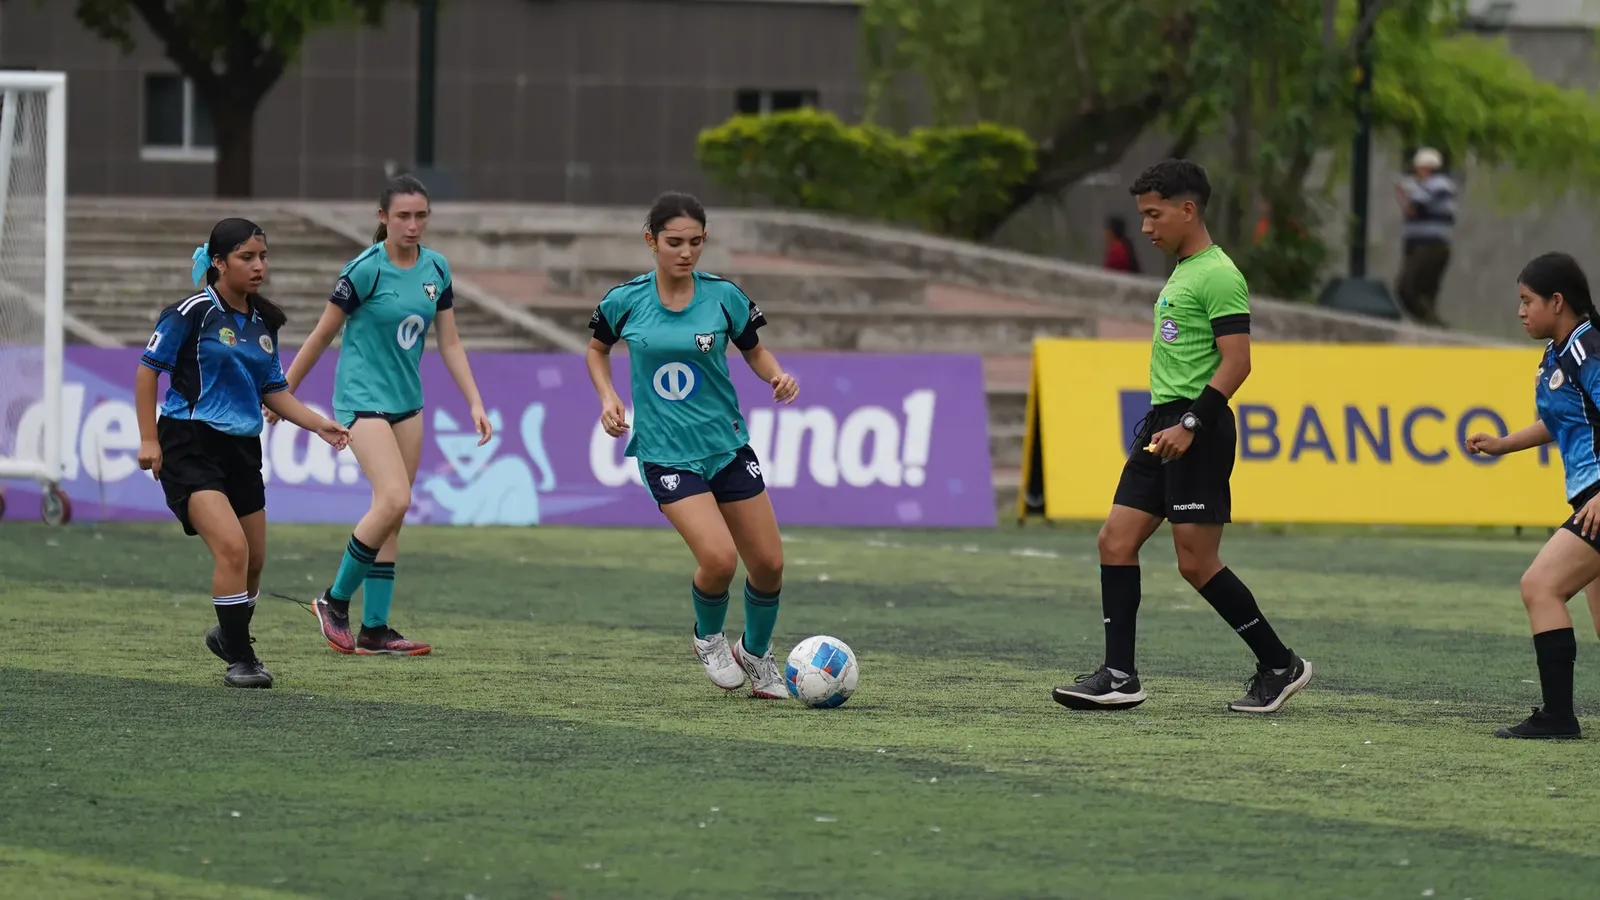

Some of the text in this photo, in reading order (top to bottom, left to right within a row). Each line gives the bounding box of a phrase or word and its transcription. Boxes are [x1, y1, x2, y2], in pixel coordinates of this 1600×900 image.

[1237, 403, 1509, 466] BANCO
[746, 461, 760, 479] 16
[1173, 502, 1205, 511] marathon
